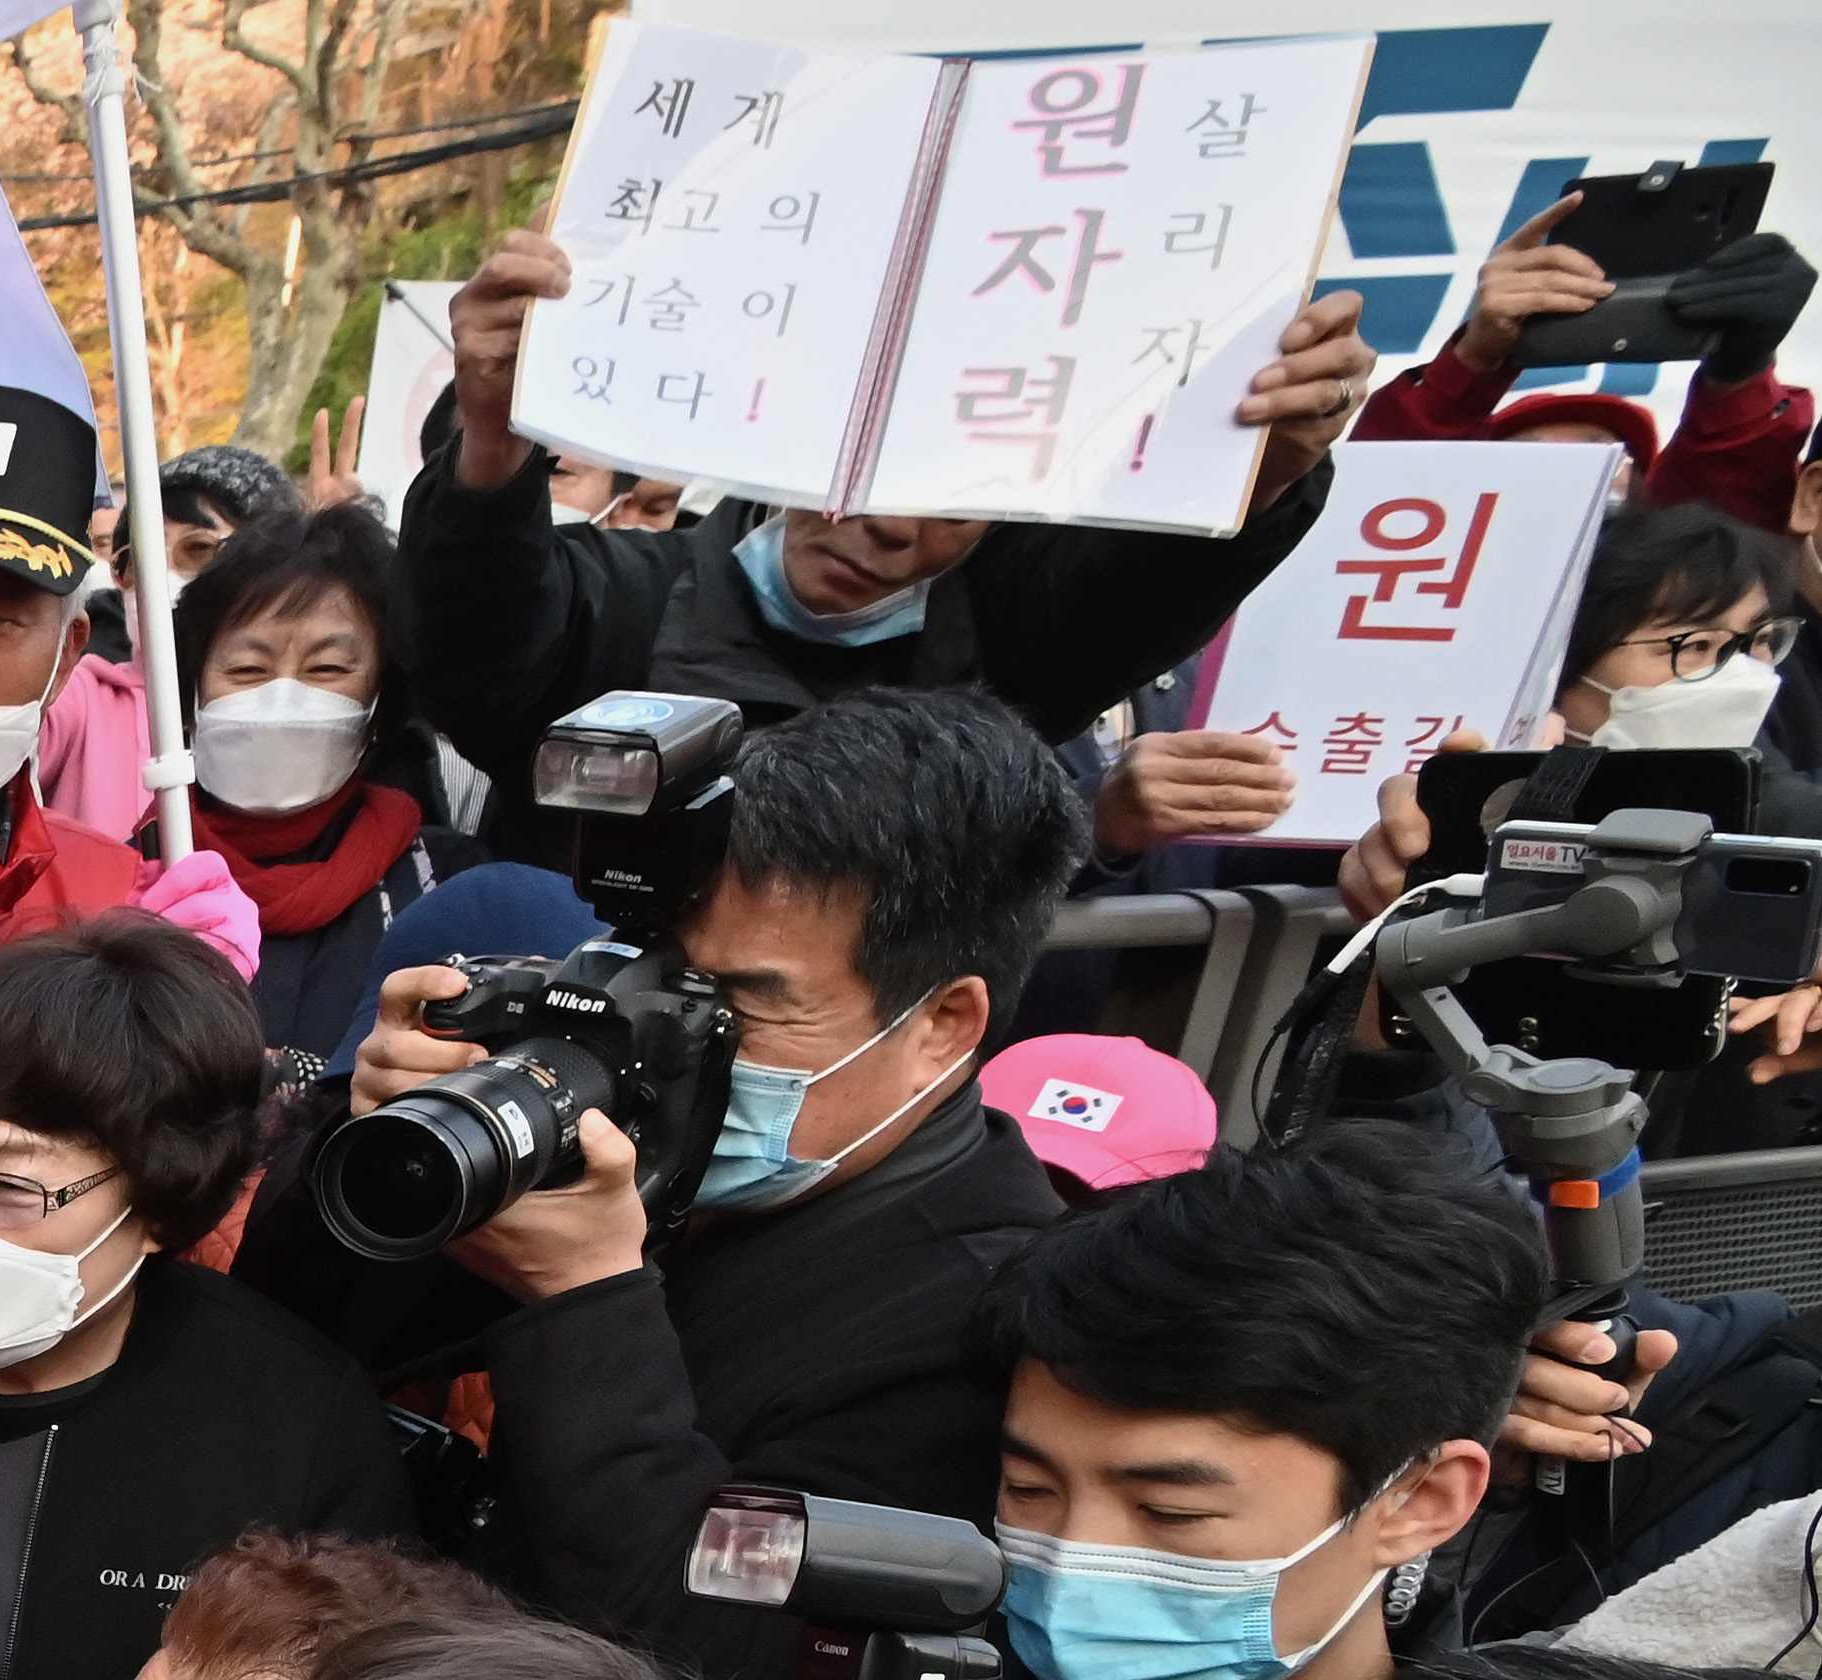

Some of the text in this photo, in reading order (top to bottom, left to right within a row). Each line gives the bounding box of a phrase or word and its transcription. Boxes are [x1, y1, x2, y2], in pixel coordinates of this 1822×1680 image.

[633, 76, 783, 150] 세계
[604, 175, 822, 247] 최고의
[580, 273, 798, 338] 기술이
[952, 62, 1147, 483] 원자력
[569, 355, 767, 422] 있다!
[1335, 492, 1500, 642] 원
[604, 869, 643, 884] Nikon
[546, 990, 607, 1013] Nikon
[99, 1569, 194, 1591] OR A DR
[814, 1640, 849, 1656] Canon
